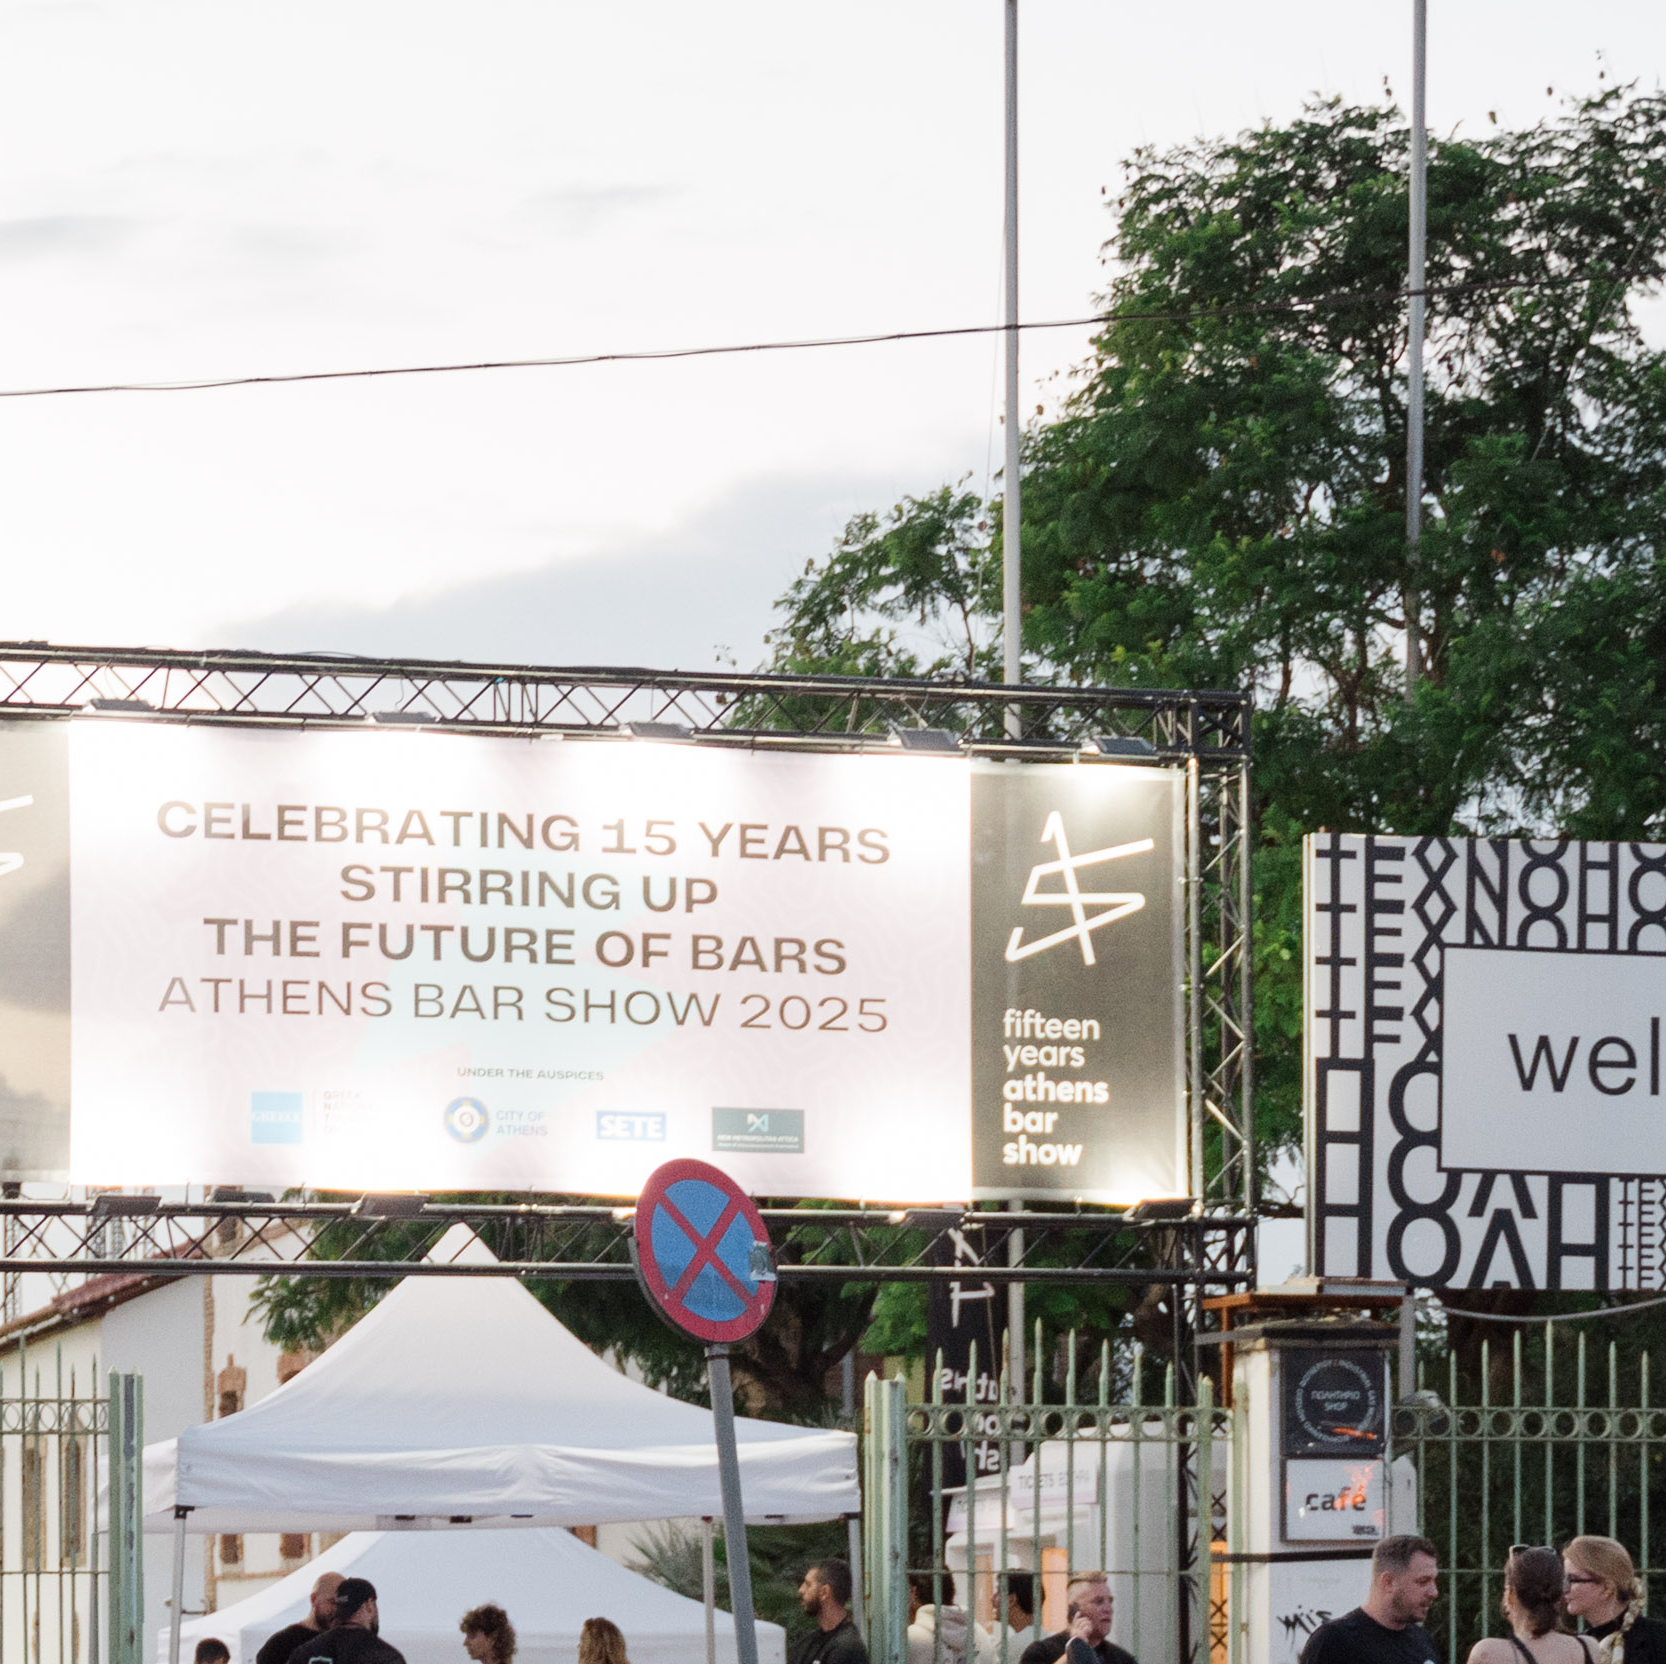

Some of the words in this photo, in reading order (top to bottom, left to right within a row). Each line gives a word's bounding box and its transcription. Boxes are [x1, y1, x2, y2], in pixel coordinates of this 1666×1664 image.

[157, 800, 580, 851] CELEBRATING
[600, 819, 678, 857] 15
[698, 823, 892, 865] YEARS
[340, 864, 621, 911] STIRRING
[641, 876, 720, 914] UP
[203, 918, 322, 959] THE
[341, 922, 576, 967] FUTURE
[594, 928, 671, 970] OF
[689, 935, 848, 977] BARS
[158, 976, 393, 1020] ATHENS
[413, 984, 525, 1024] BAR
[543, 987, 722, 1029] SHOW
[738, 992, 889, 1035] 2025
[1002, 1008, 1101, 1043] fifteen
[1002, 1045, 1086, 1071] years
[457, 1066, 505, 1078] UNDER
[508, 1067, 534, 1079] THE
[537, 1069, 605, 1081] AUSPICES
[1002, 1073, 1110, 1105] athens
[496, 1110, 525, 1122] CITY
[599, 1113, 664, 1139] SETE
[1002, 1103, 1060, 1136] bar
[496, 1125, 549, 1137] ATHENS
[1002, 1140, 1084, 1167] show
[1017, 1472, 1055, 1491] TICETS
[1305, 1484, 1368, 1512] café
